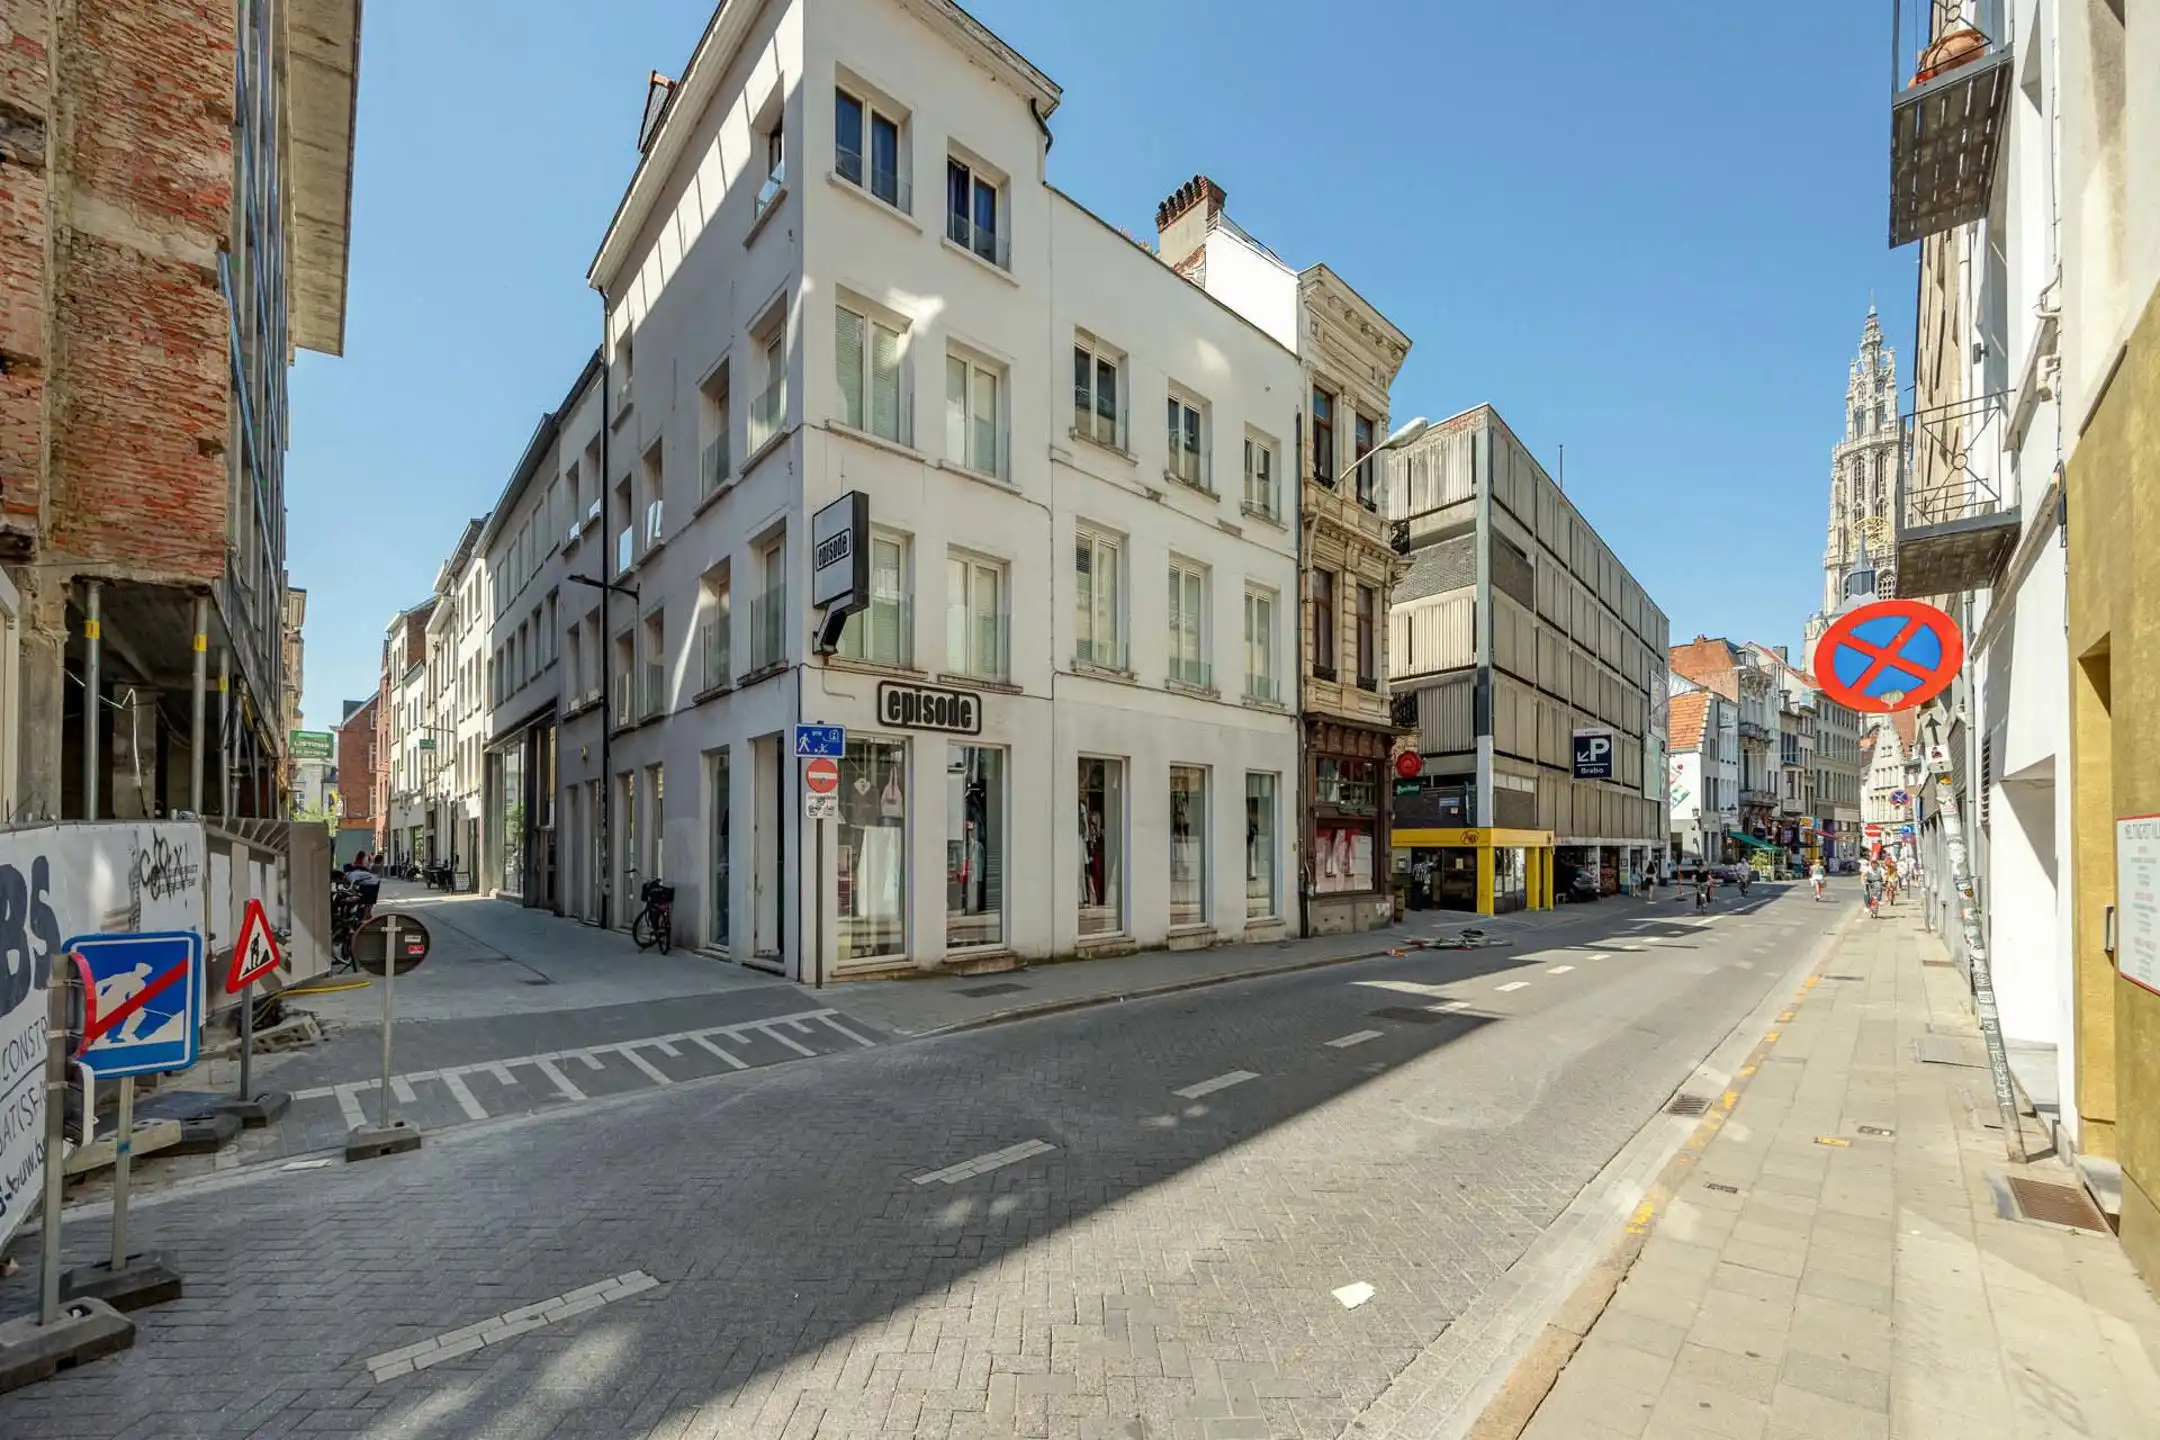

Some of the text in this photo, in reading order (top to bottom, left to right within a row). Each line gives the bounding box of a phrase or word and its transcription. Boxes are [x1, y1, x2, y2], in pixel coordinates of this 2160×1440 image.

[818, 533, 848, 566] episode
[887, 686, 972, 729] episode
[1590, 738, 1610, 762] P
